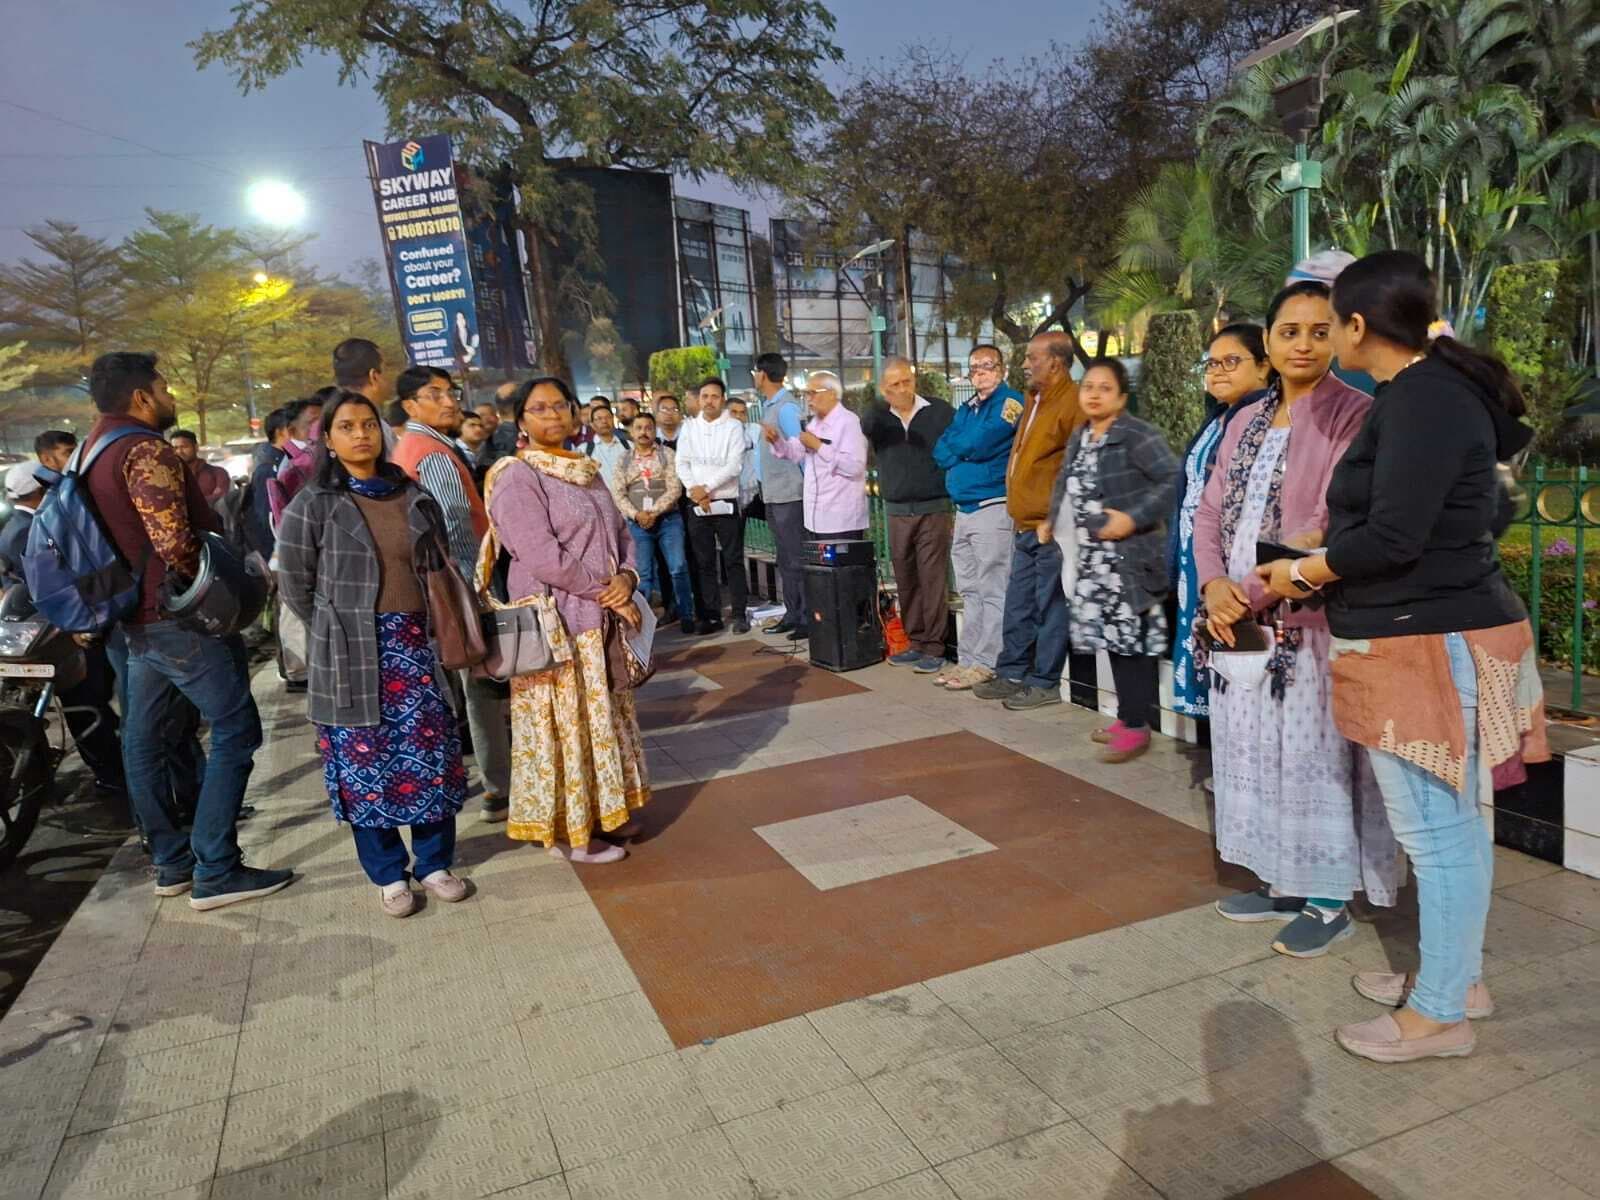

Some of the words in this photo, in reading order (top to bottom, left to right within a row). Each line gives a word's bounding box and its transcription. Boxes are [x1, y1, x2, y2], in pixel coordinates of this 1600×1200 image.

[380, 167, 451, 196] SKYWAY
[382, 193, 428, 211] CAREER
[429, 188, 456, 203] HUB
[400, 243, 454, 261] Confused
[403, 260, 432, 273] about
[432, 259, 454, 272] your
[405, 267, 461, 289] Career?
[407, 293, 431, 306] DON'T
